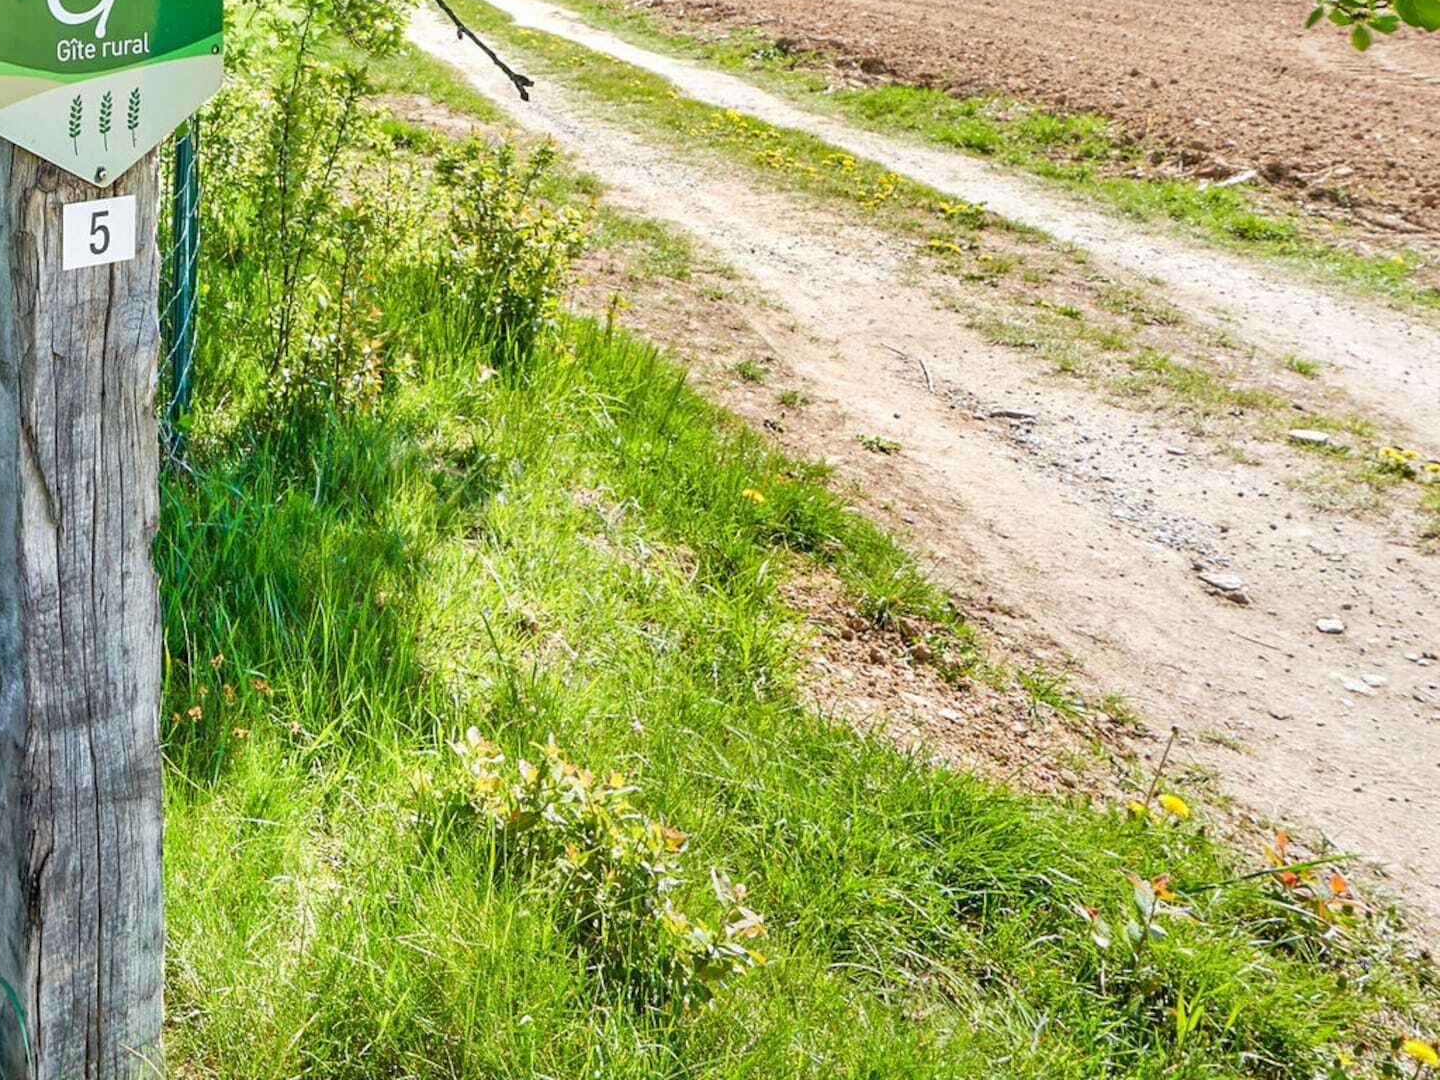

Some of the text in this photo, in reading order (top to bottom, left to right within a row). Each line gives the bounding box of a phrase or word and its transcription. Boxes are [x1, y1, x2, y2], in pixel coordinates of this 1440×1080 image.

[56, 31, 150, 62] Gîte rural
[88, 210, 111, 256] 5
